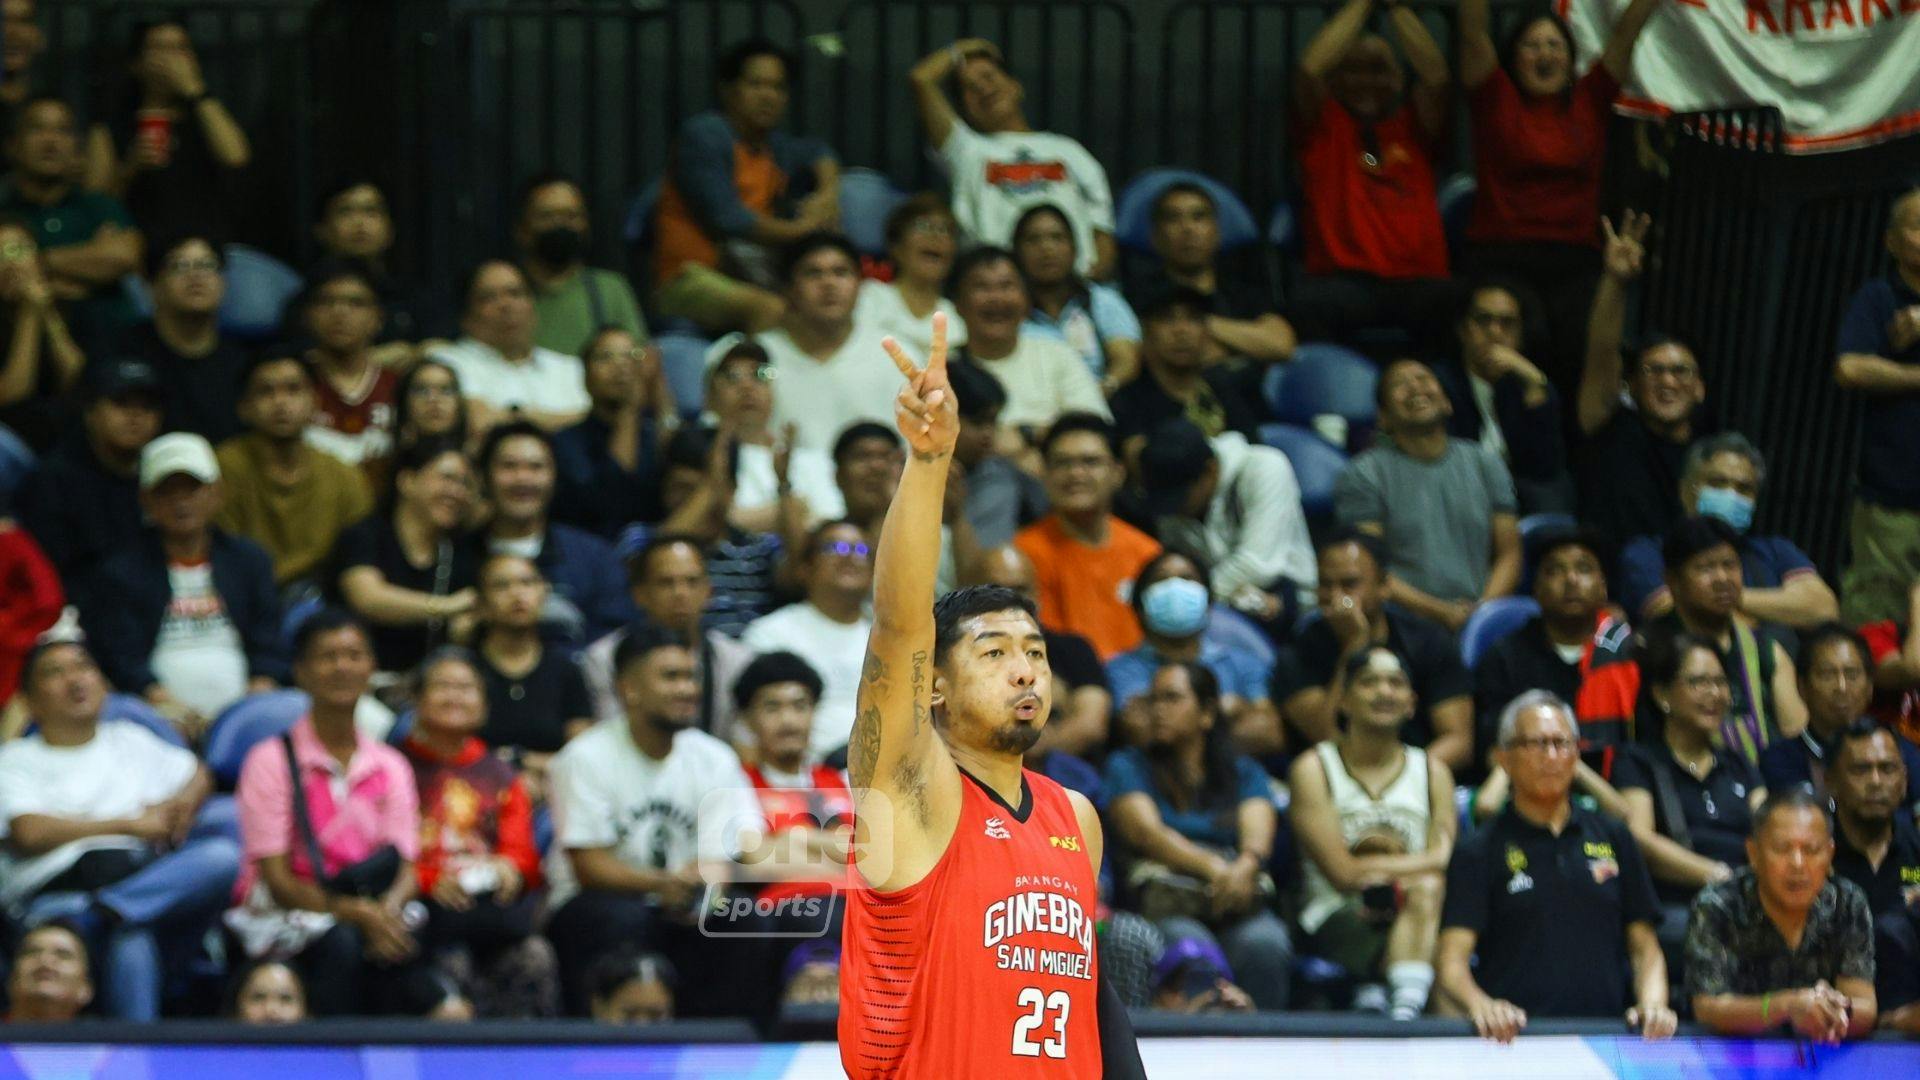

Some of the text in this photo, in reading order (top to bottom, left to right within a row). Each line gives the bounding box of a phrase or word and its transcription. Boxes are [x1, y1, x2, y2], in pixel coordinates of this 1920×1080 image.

[983, 891, 1093, 964] GINEBRA
[997, 944, 1093, 980] SAN MIGUEL
[1011, 986, 1071, 1059] 23
